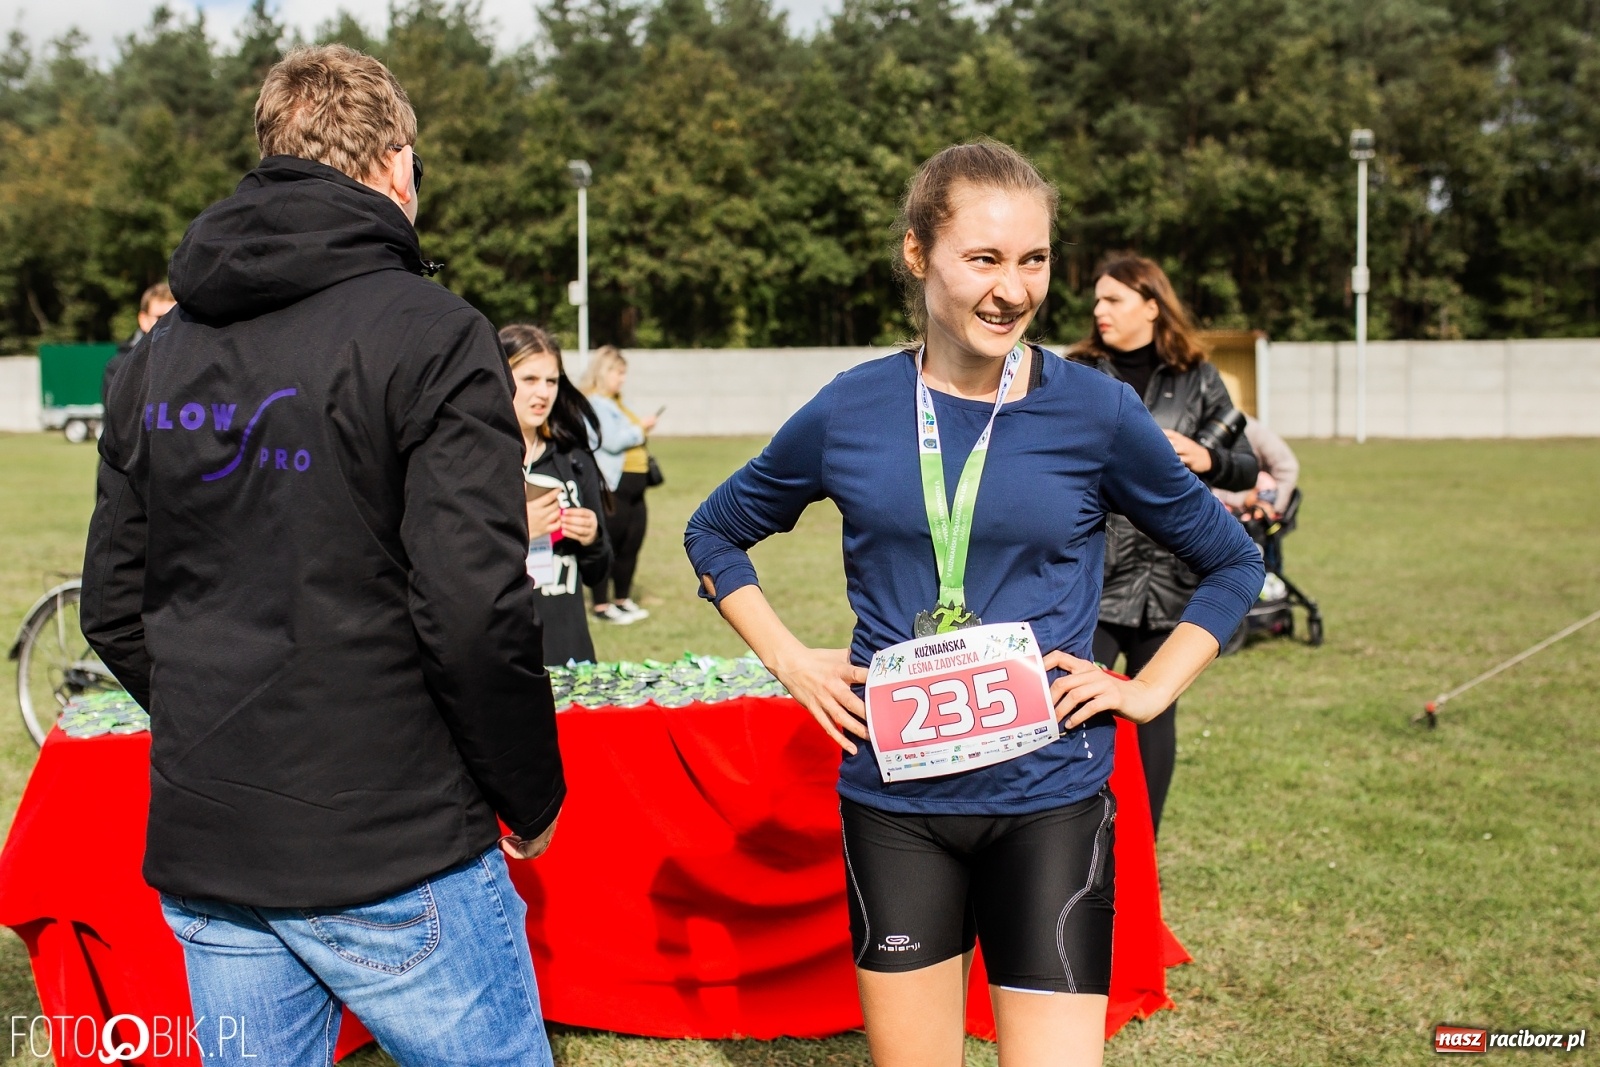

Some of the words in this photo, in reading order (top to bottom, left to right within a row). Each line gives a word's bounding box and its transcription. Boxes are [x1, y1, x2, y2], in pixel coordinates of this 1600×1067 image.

[145, 402, 237, 431] FLOW
[259, 448, 311, 472] PRO
[908, 662, 932, 676] LEŚNA
[935, 651, 980, 670] ZADYSZKA
[891, 667, 1018, 744] 235
